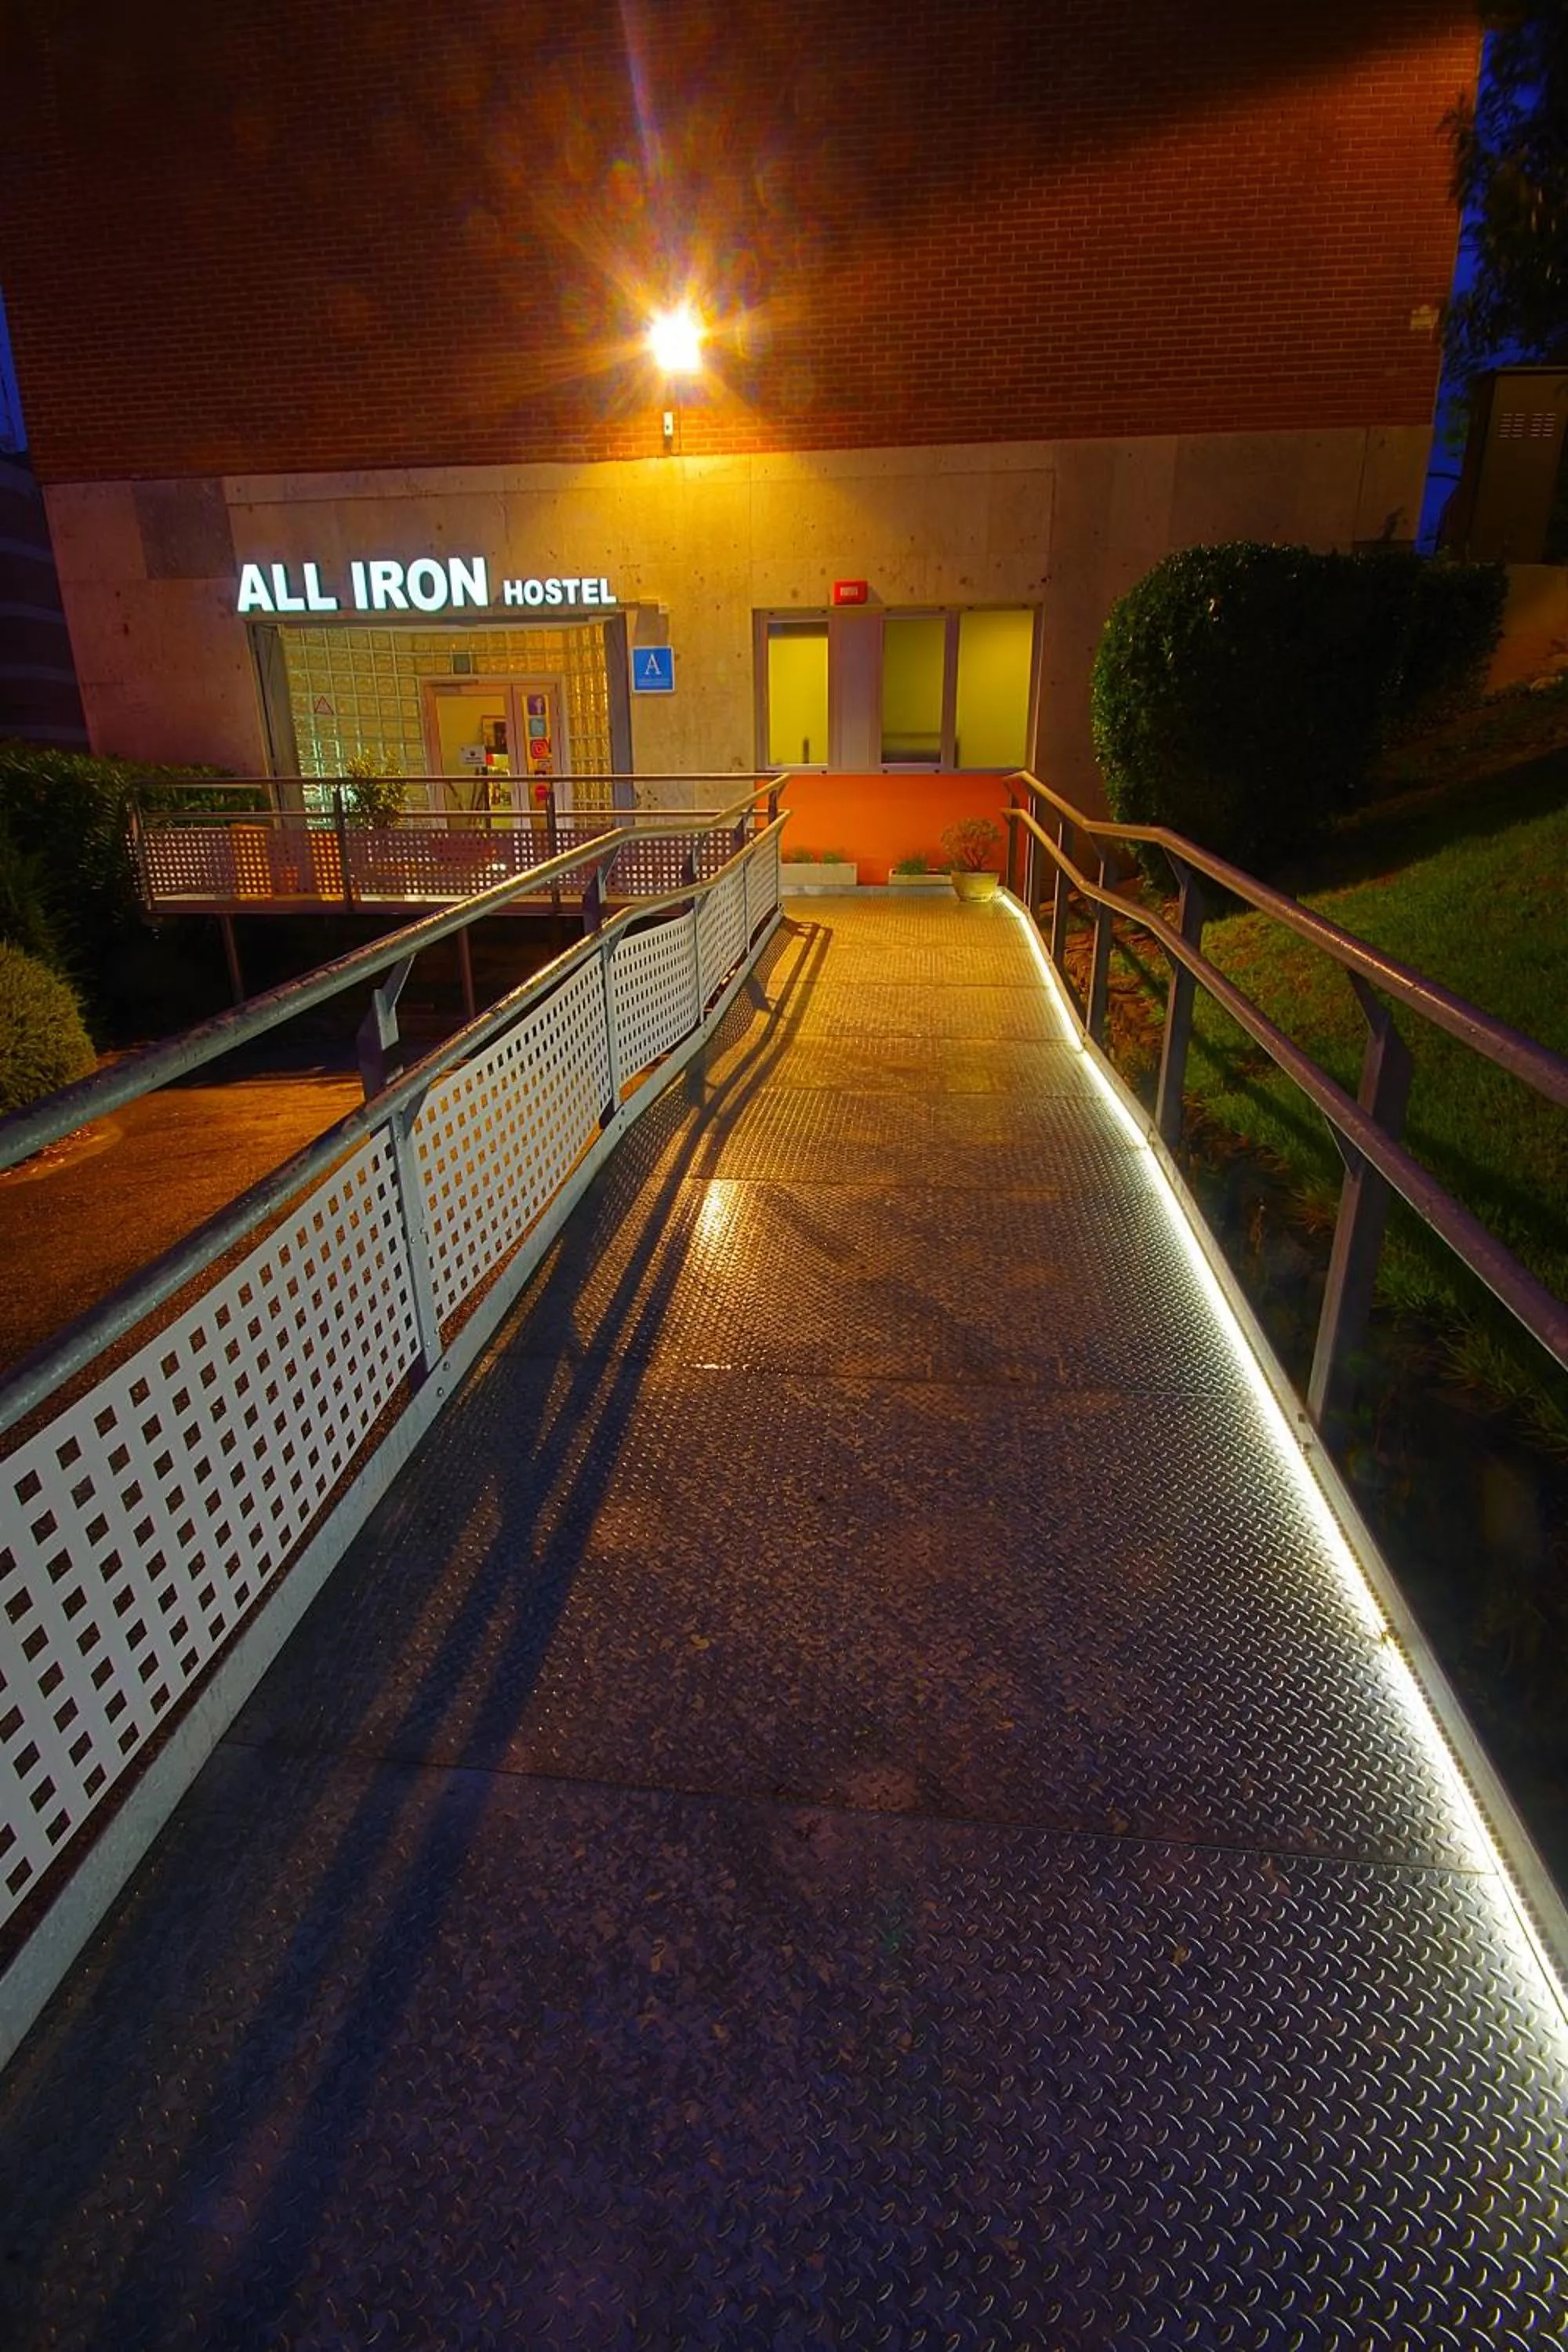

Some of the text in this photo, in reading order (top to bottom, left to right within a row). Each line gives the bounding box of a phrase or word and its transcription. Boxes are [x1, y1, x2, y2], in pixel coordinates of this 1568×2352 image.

[238, 557, 618, 612] ALL IRON HOSTEL
[644, 653, 662, 675] A
